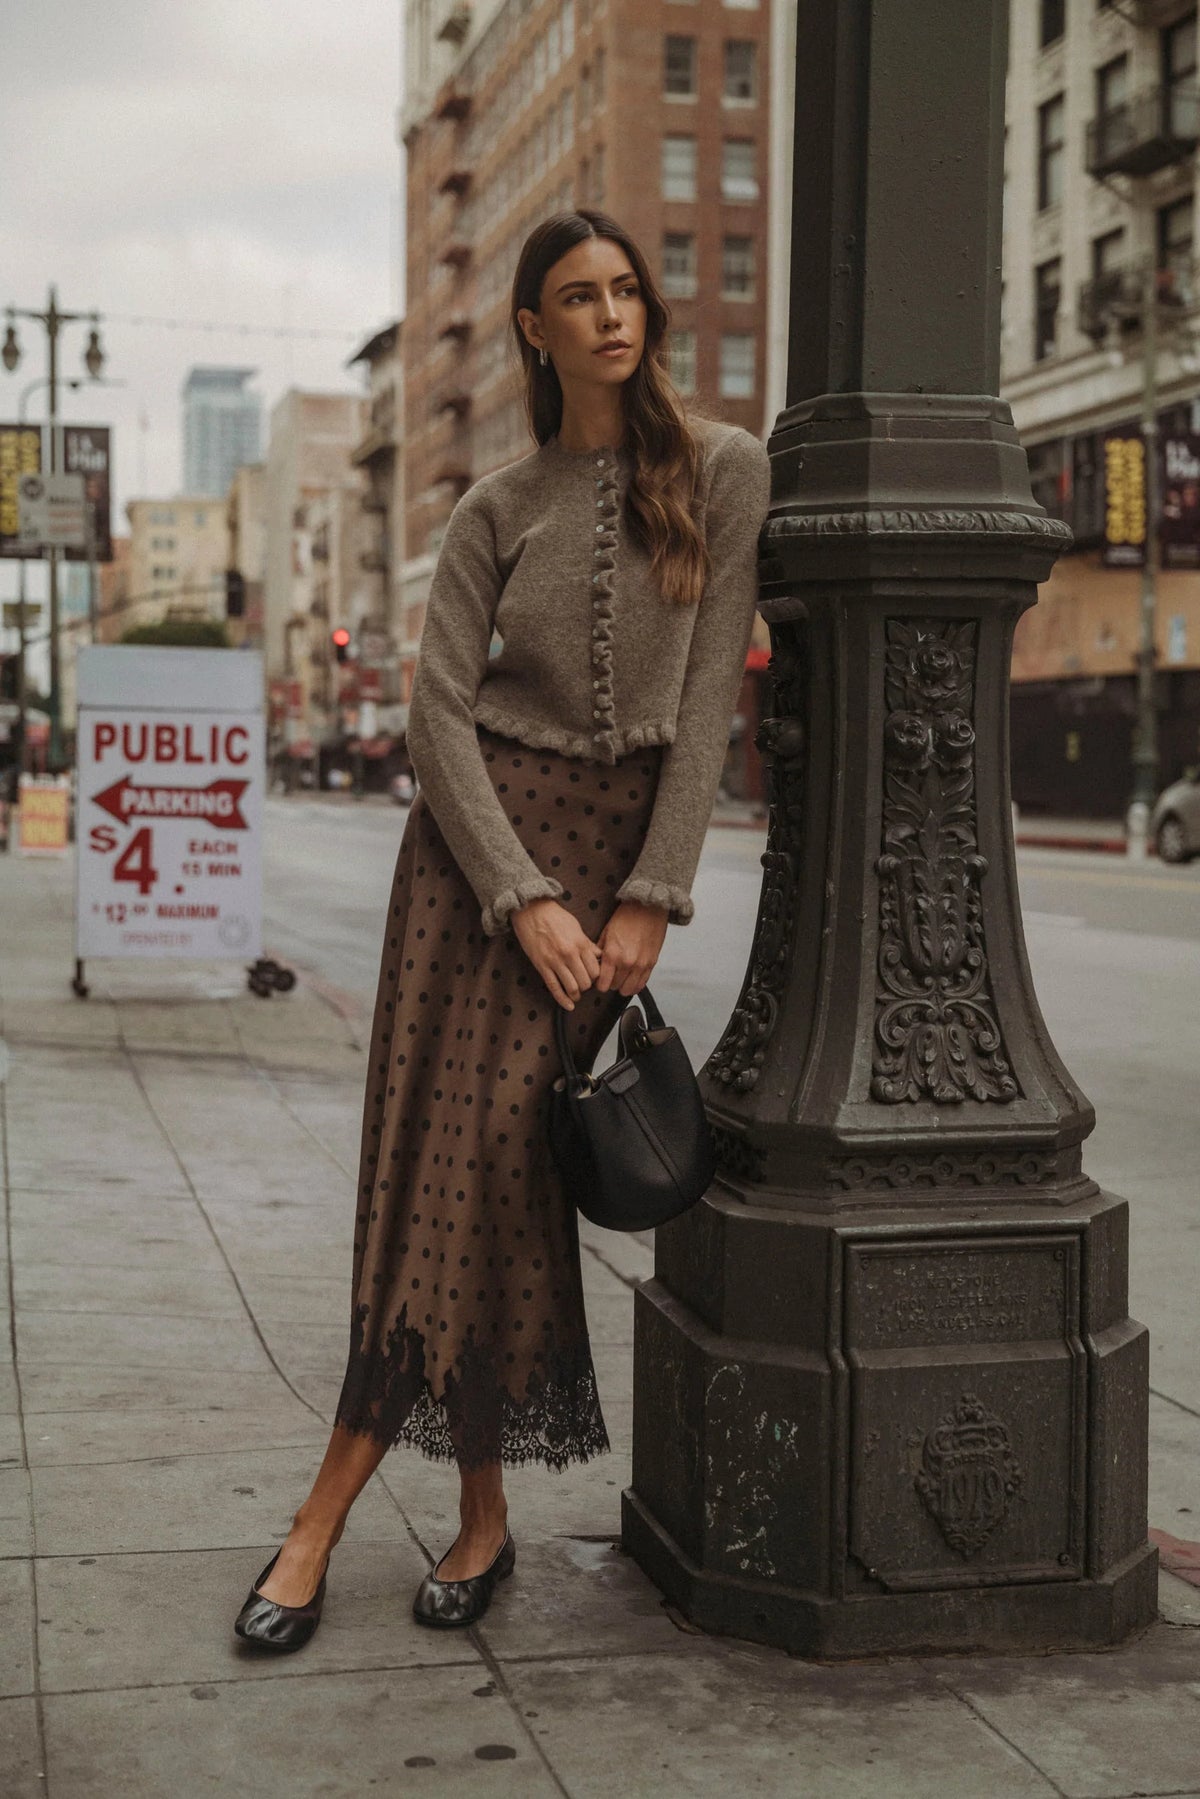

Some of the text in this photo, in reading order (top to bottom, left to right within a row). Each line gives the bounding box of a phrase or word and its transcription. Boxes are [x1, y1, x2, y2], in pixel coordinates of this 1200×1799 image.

[94, 722, 249, 765] PUBLIC
[120, 789, 235, 817] PARKING
[187, 839, 238, 856] EACH
[182, 862, 242, 877] 15 MIN
[156, 903, 220, 920] MAXIMUM
[926, 1274, 1002, 1290] KEYSTONE
[898, 1317, 927, 1332] LOS
